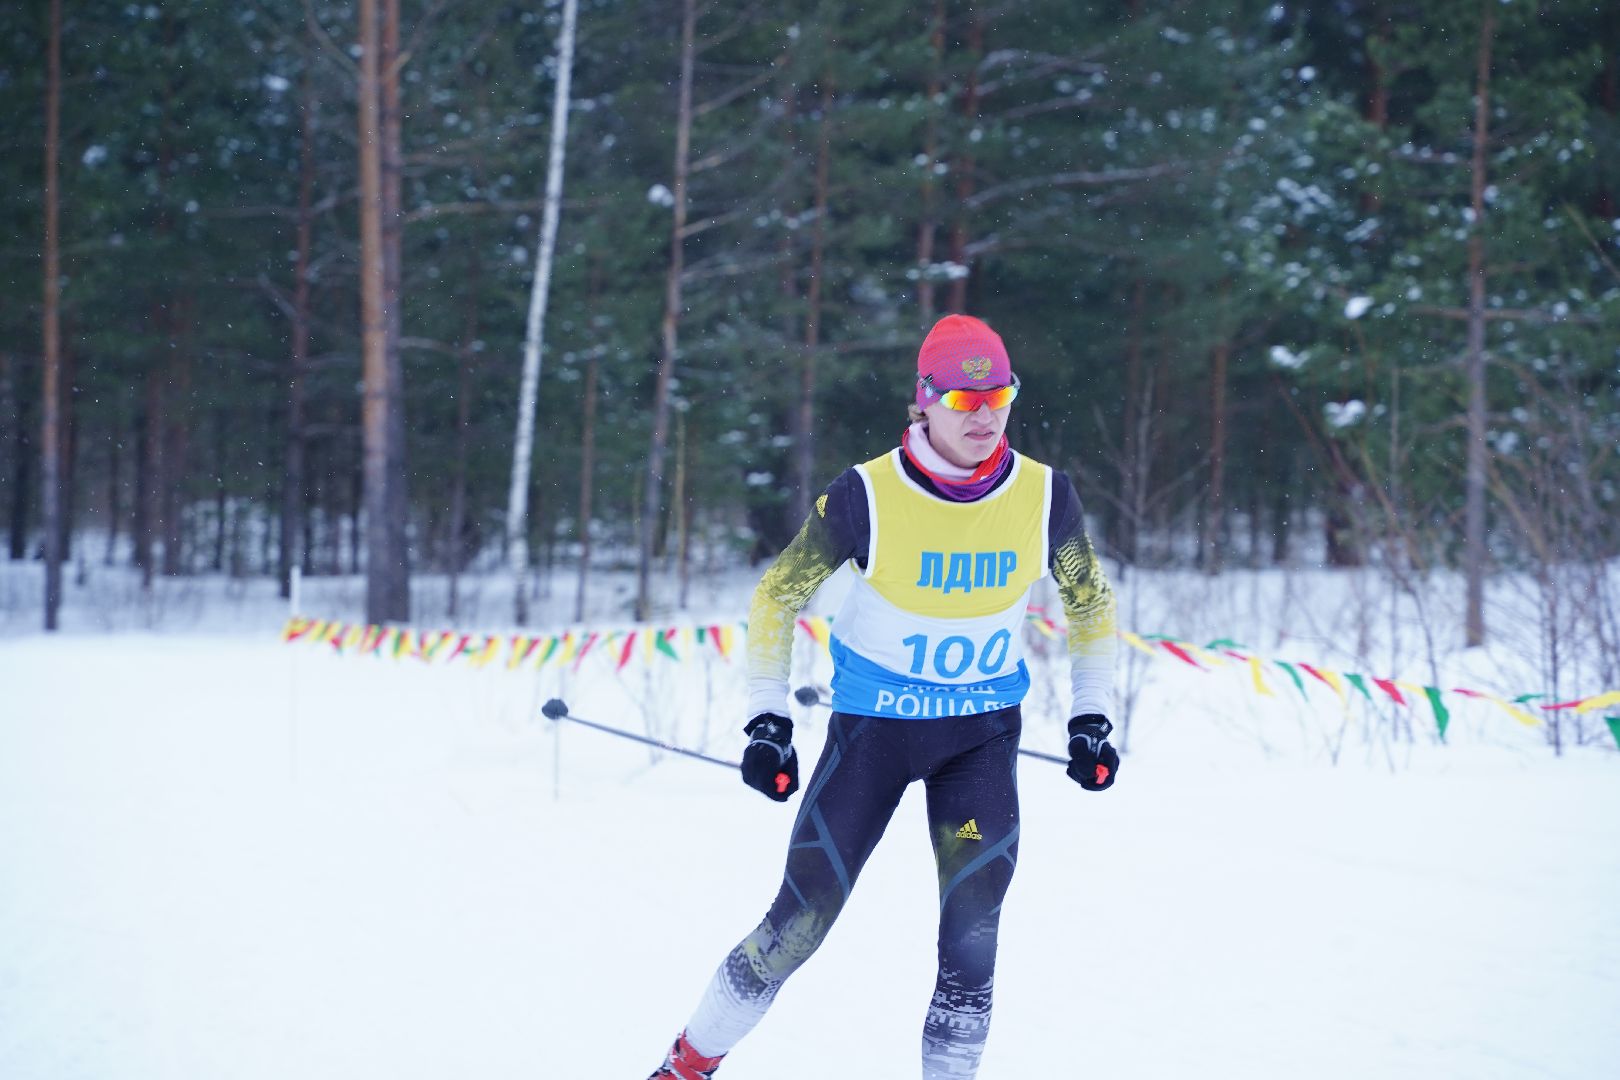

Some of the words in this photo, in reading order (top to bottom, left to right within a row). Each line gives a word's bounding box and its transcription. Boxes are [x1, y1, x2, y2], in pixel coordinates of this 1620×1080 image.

[916, 551, 1018, 594] ЛДПР
[902, 628, 1011, 679] 100
[874, 689, 1020, 717] РОША
[955, 831, 983, 841] adidas
